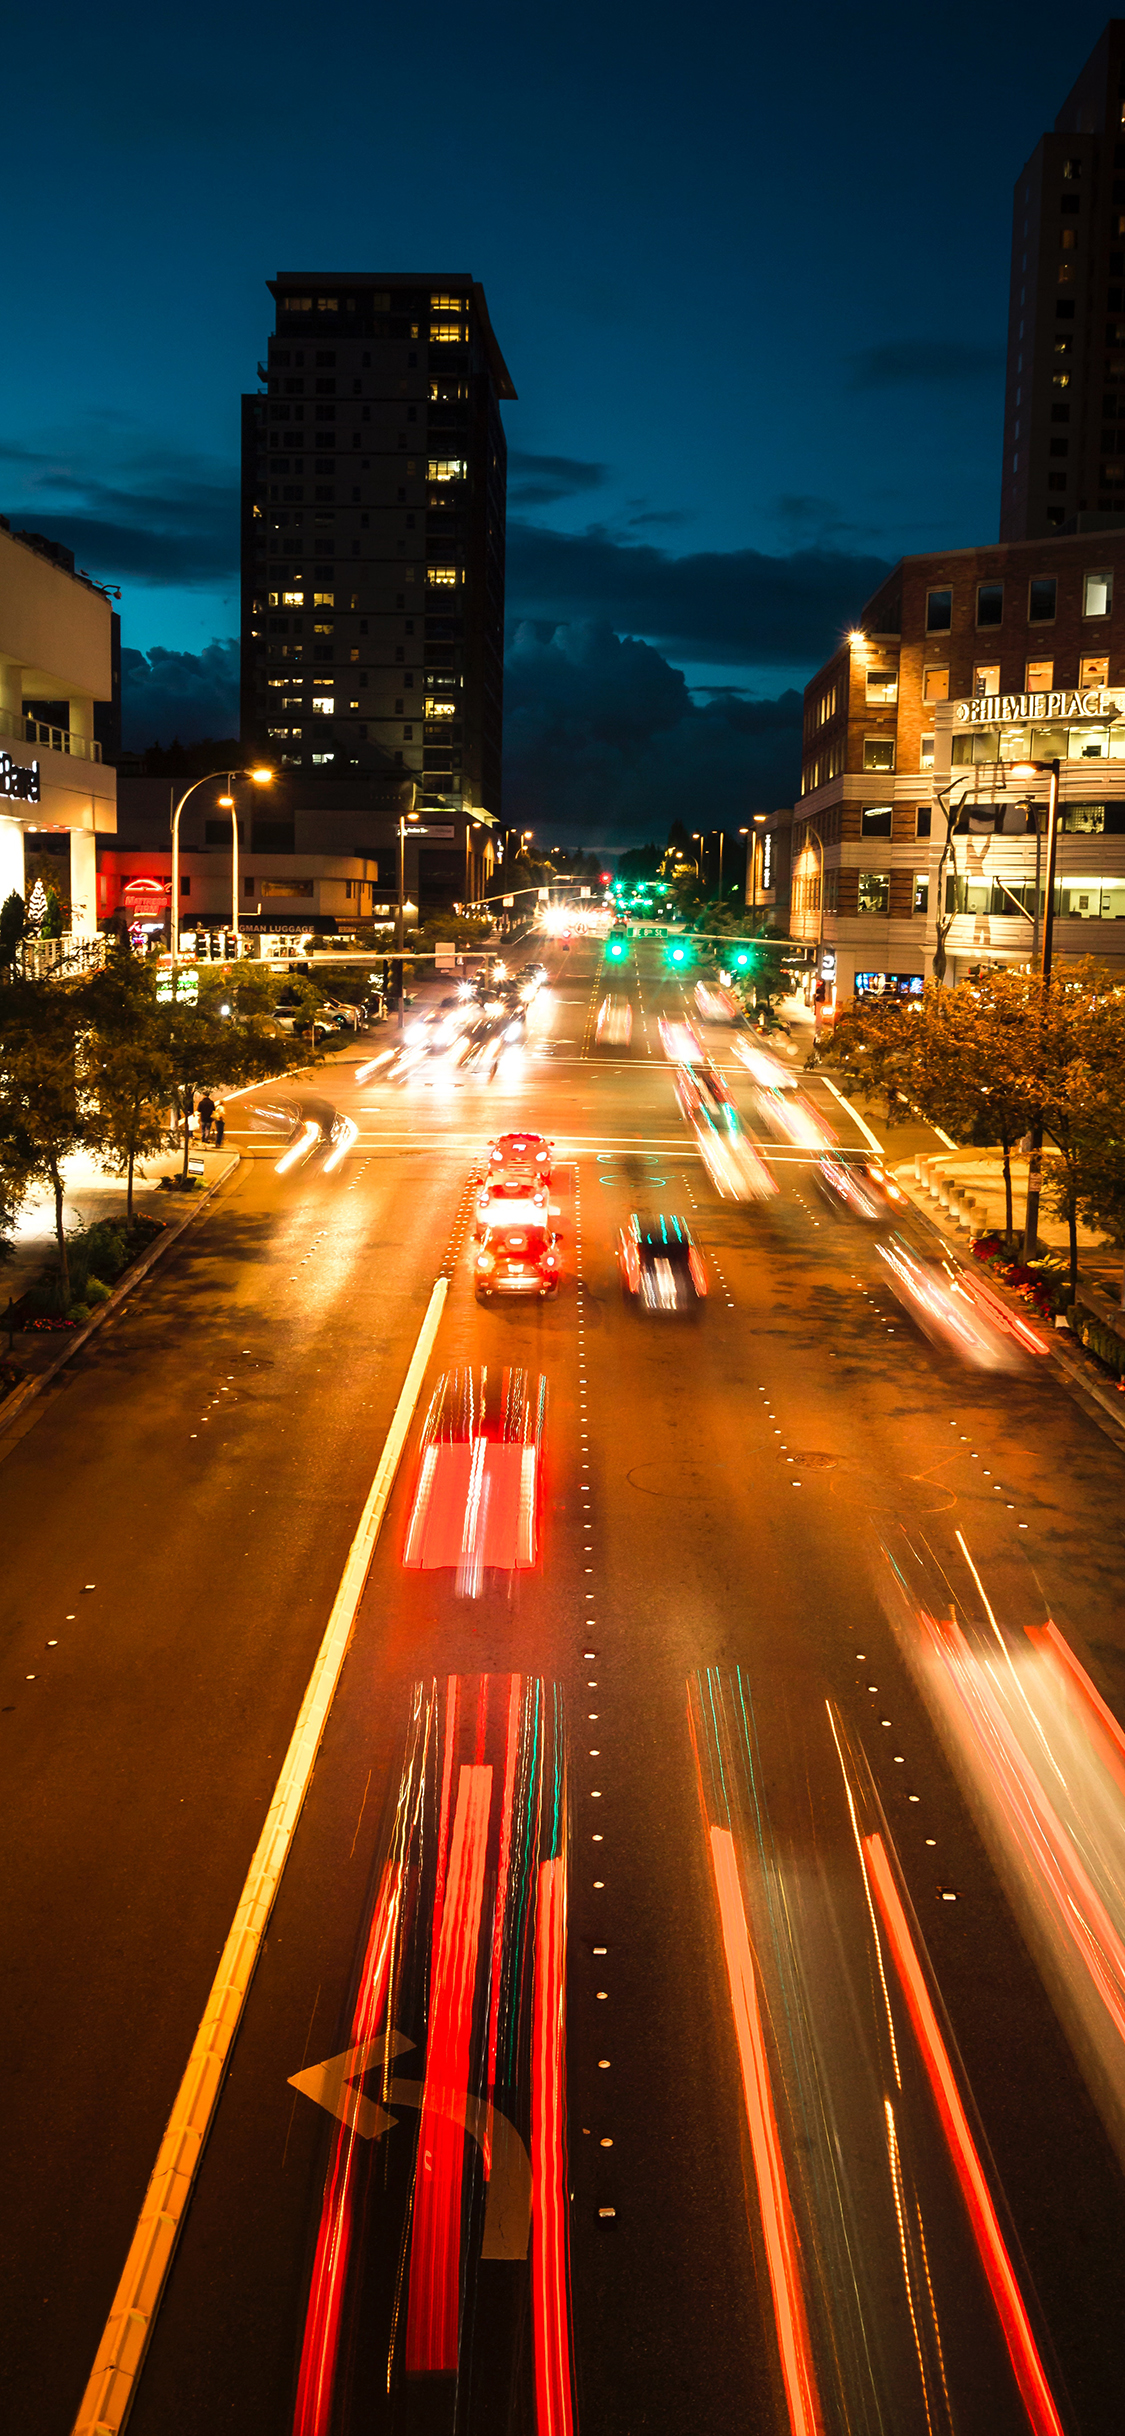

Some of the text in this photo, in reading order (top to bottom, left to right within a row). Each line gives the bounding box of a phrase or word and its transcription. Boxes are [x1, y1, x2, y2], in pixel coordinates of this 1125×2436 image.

[970, 692, 1111, 722] BELLEVUE PLACE
[269, 925, 315, 933] LUGGAGE
